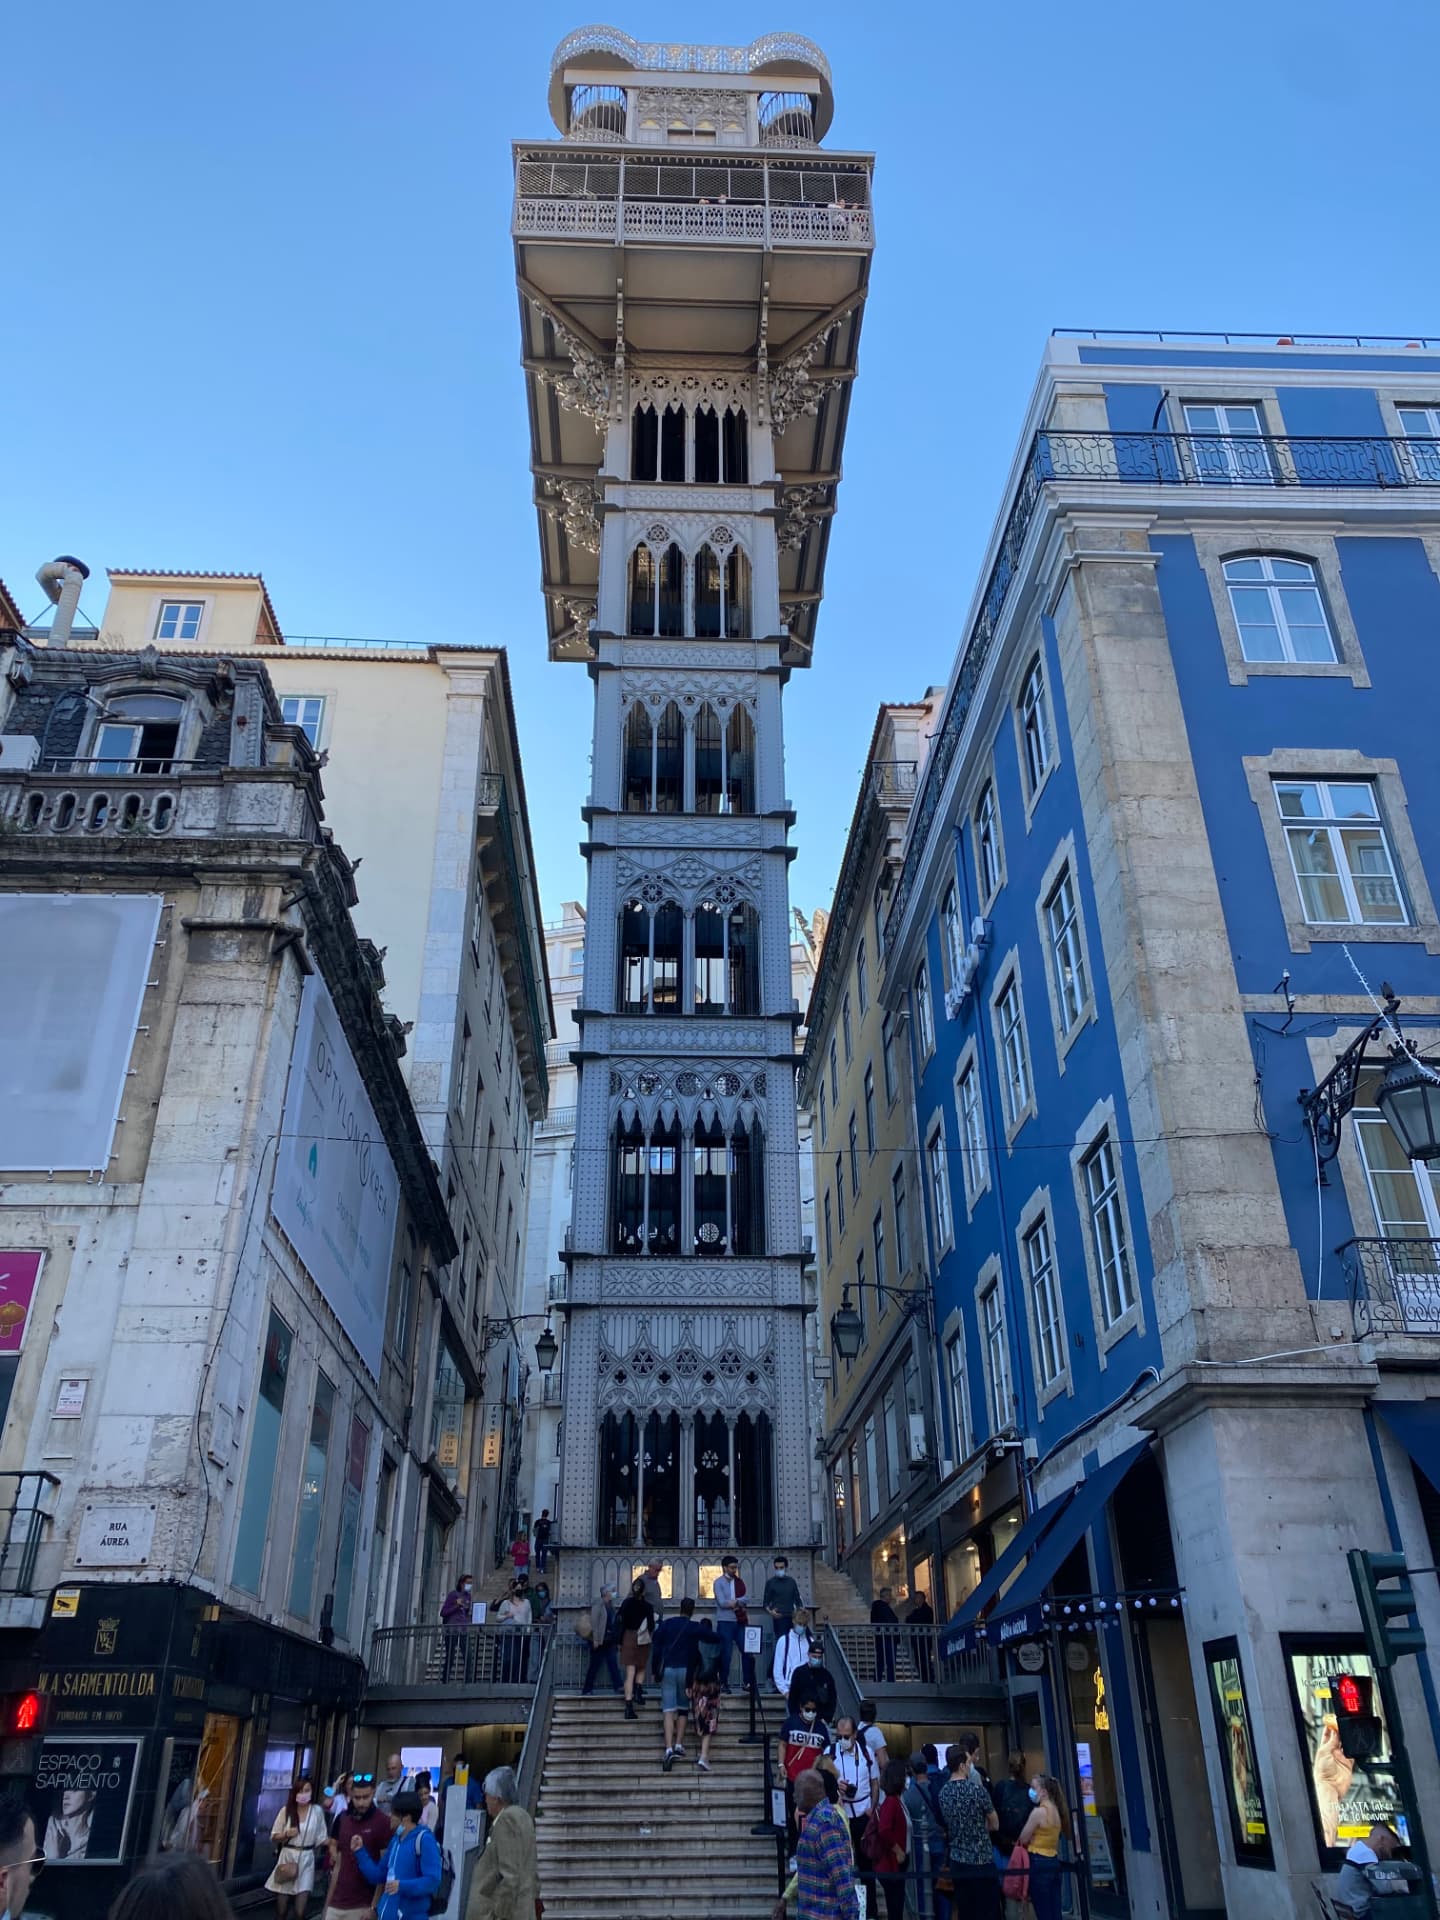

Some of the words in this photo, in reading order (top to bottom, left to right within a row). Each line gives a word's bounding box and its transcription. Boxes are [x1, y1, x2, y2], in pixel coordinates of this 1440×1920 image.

[108, 1522, 128, 1531] RUA
[100, 1534, 130, 1546] ÁUREA
[38, 1754, 102, 1773] ESPAÇO
[35, 1772, 121, 1790] SARMENTO
